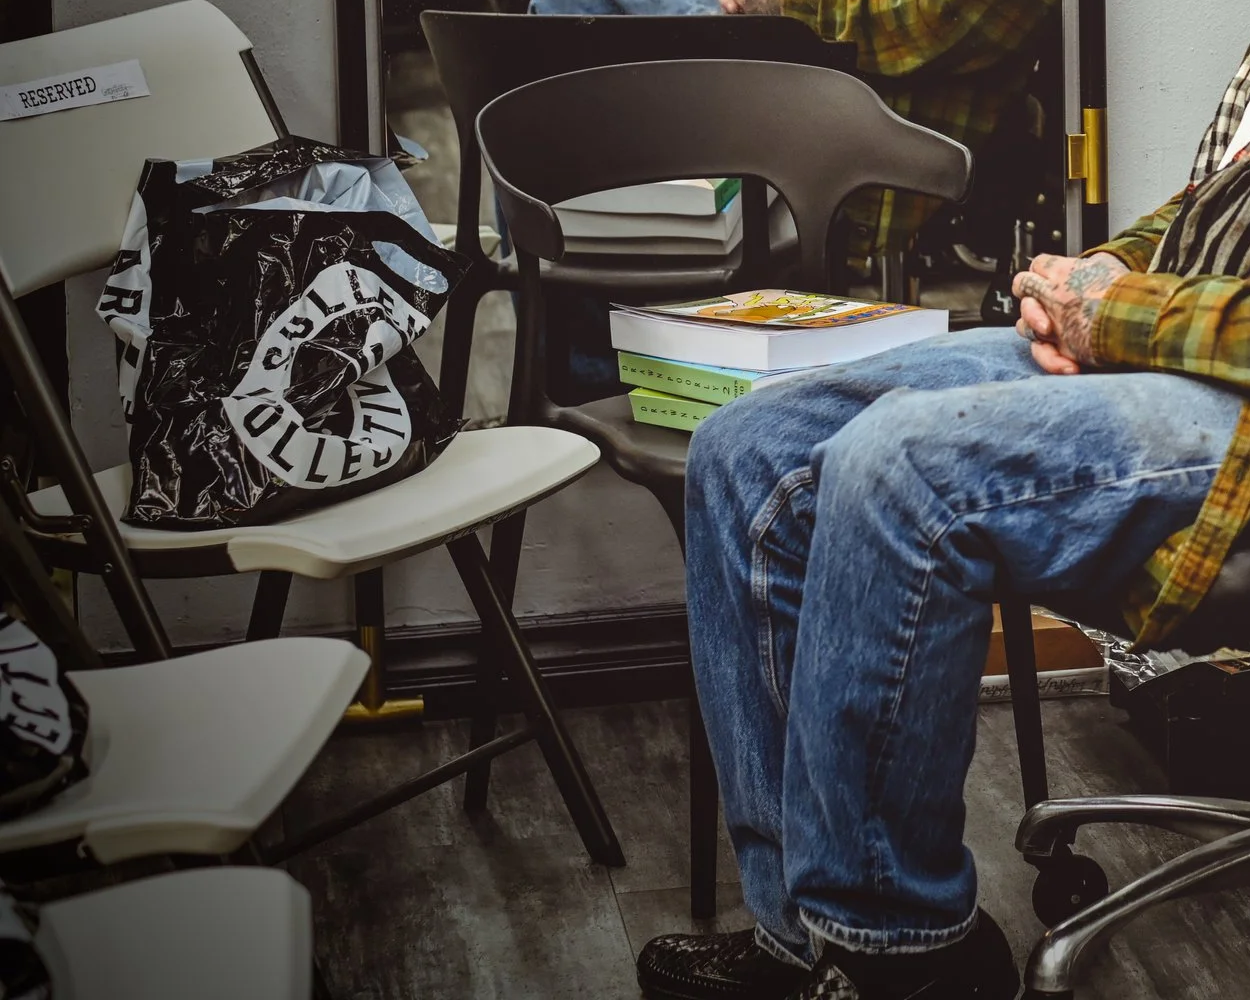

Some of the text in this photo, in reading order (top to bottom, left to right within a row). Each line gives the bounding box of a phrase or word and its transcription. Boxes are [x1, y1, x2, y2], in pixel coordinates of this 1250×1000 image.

[18, 76, 97, 109] RESERVED
[622, 365, 664, 379] DRAWN
[666, 376, 720, 392] POORLY
[640, 405, 688, 418] DRAWN
